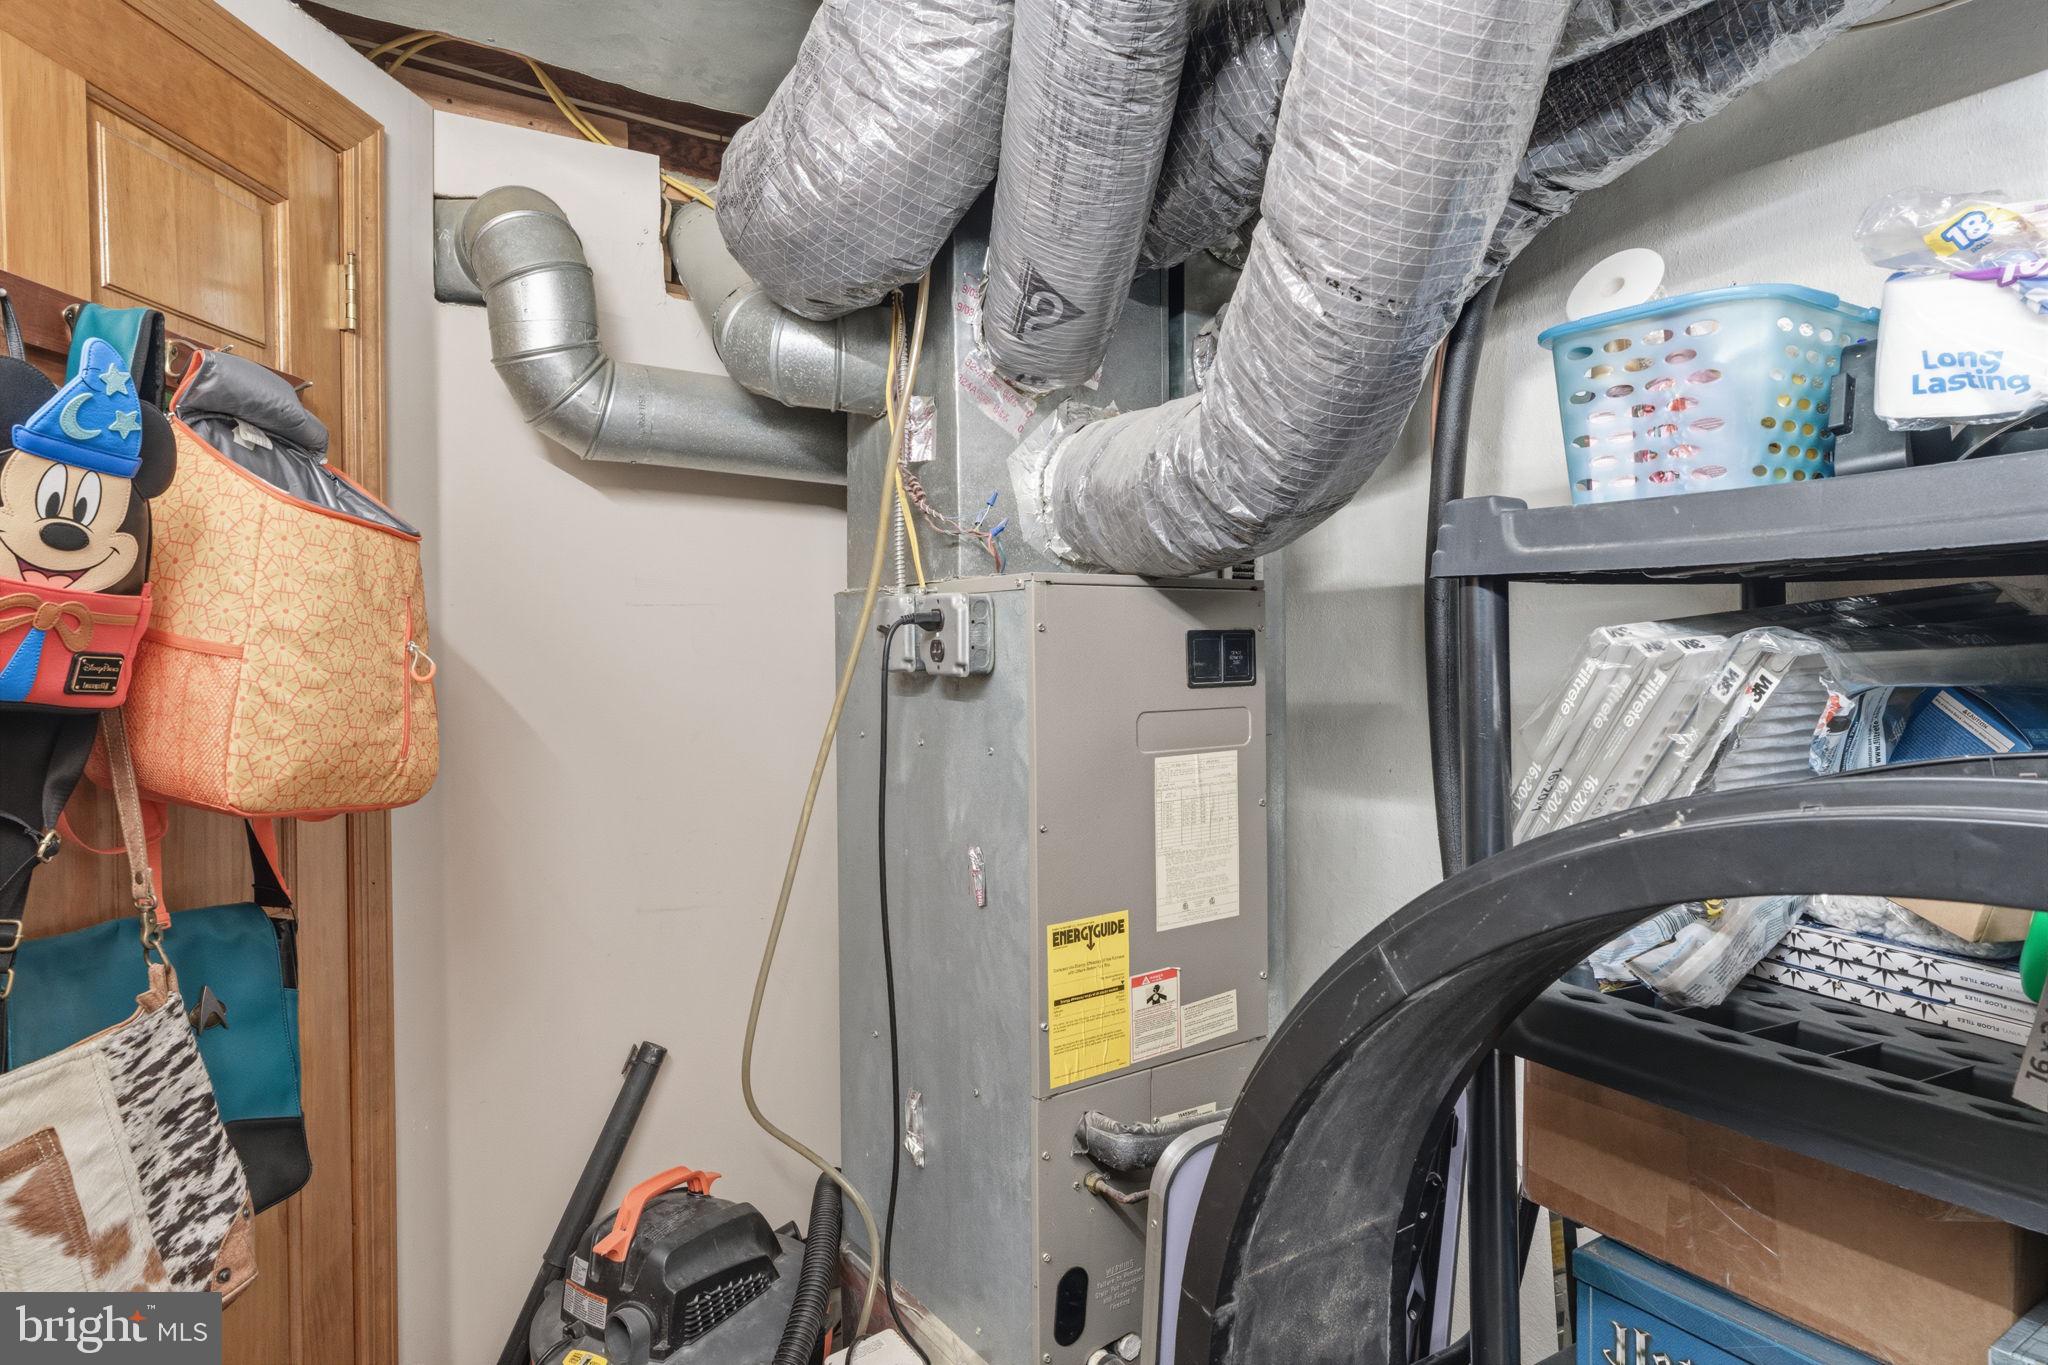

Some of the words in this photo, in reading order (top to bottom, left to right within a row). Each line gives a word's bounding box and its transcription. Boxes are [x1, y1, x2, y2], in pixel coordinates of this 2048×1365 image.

[1941, 210, 1988, 250] 18
[1922, 350, 2004, 374] Long
[1912, 369, 2032, 395] Lasting
[1680, 639, 1706, 650] 3M
[1560, 658, 1601, 716] Filtrete
[1716, 668, 1741, 697] 3M
[1753, 674, 1774, 704] 3M
[1622, 668, 1668, 728] Filtrete
[1541, 775, 1573, 824] 16x20x1
[1563, 774, 1600, 826] 16x20x1
[1052, 919, 1125, 950] ENERGYGUIDE
[1959, 975, 1978, 985] TILES
[1980, 980, 2004, 991] FLOOR
[1964, 994, 1982, 1003] TILES
[1984, 999, 2008, 1010] FLOOR
[1957, 1016, 1975, 1026] TILES
[1976, 1021, 2000, 1033] FLOOR
